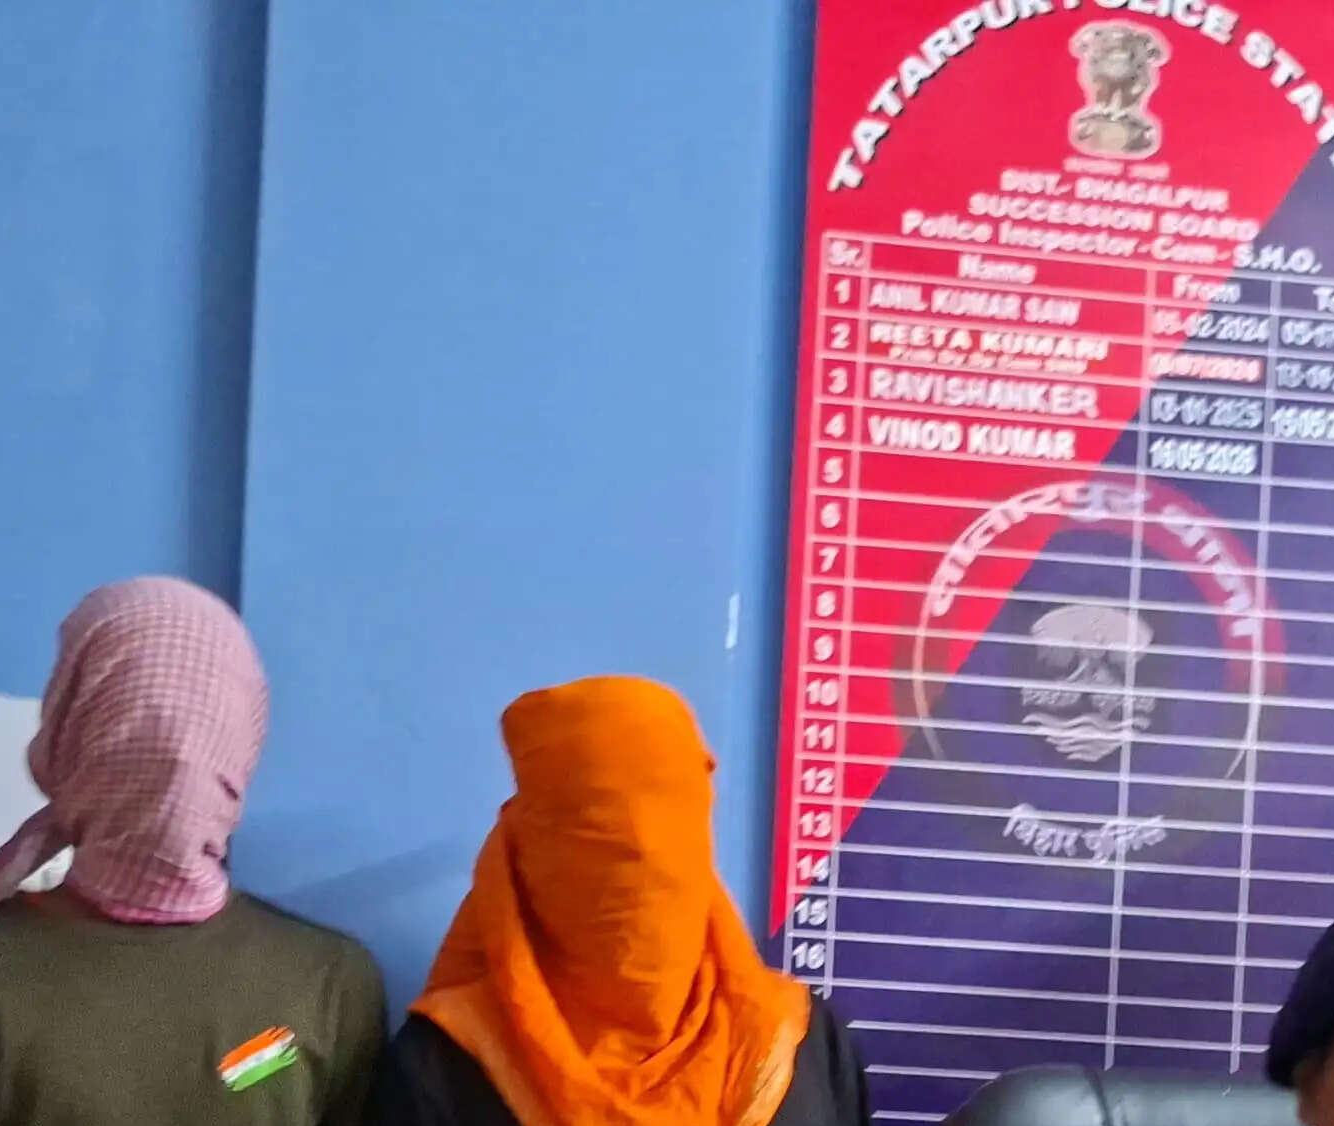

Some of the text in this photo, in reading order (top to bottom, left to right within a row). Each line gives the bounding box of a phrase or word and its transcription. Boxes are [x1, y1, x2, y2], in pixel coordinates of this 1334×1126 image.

[1064, 0, 1236, 43] ICE
[1075, 176, 1229, 212] BHAGALPUR
[902, 209, 993, 243] Police
[969, 192, 1259, 240] SUCCESSION BOARD
[958, 254, 1036, 284] Name
[834, 278, 851, 304] 1
[870, 283, 928, 312] ANIL
[931, 288, 1020, 320] KUMAR
[1174, 274, 1241, 304] From
[830, 322, 851, 349] 2
[981, 330, 1107, 360] KUMARI
[828, 367, 848, 394] 3
[870, 367, 1099, 419] RAVISHANKER
[825, 412, 845, 438] 4
[869, 415, 1075, 460] VINOD KUMAR
[823, 457, 843, 483] 5
[820, 502, 841, 528] 6
[819, 546, 839, 572] 7
[816, 590, 836, 617] 8
[814, 635, 834, 661] 9
[806, 679, 839, 706] 10
[804, 724, 836, 749] 11
[802, 767, 835, 793] 12
[799, 811, 832, 837] 13
[796, 855, 830, 882] 14
[794, 898, 828, 925] 15
[792, 942, 826, 969] 16
